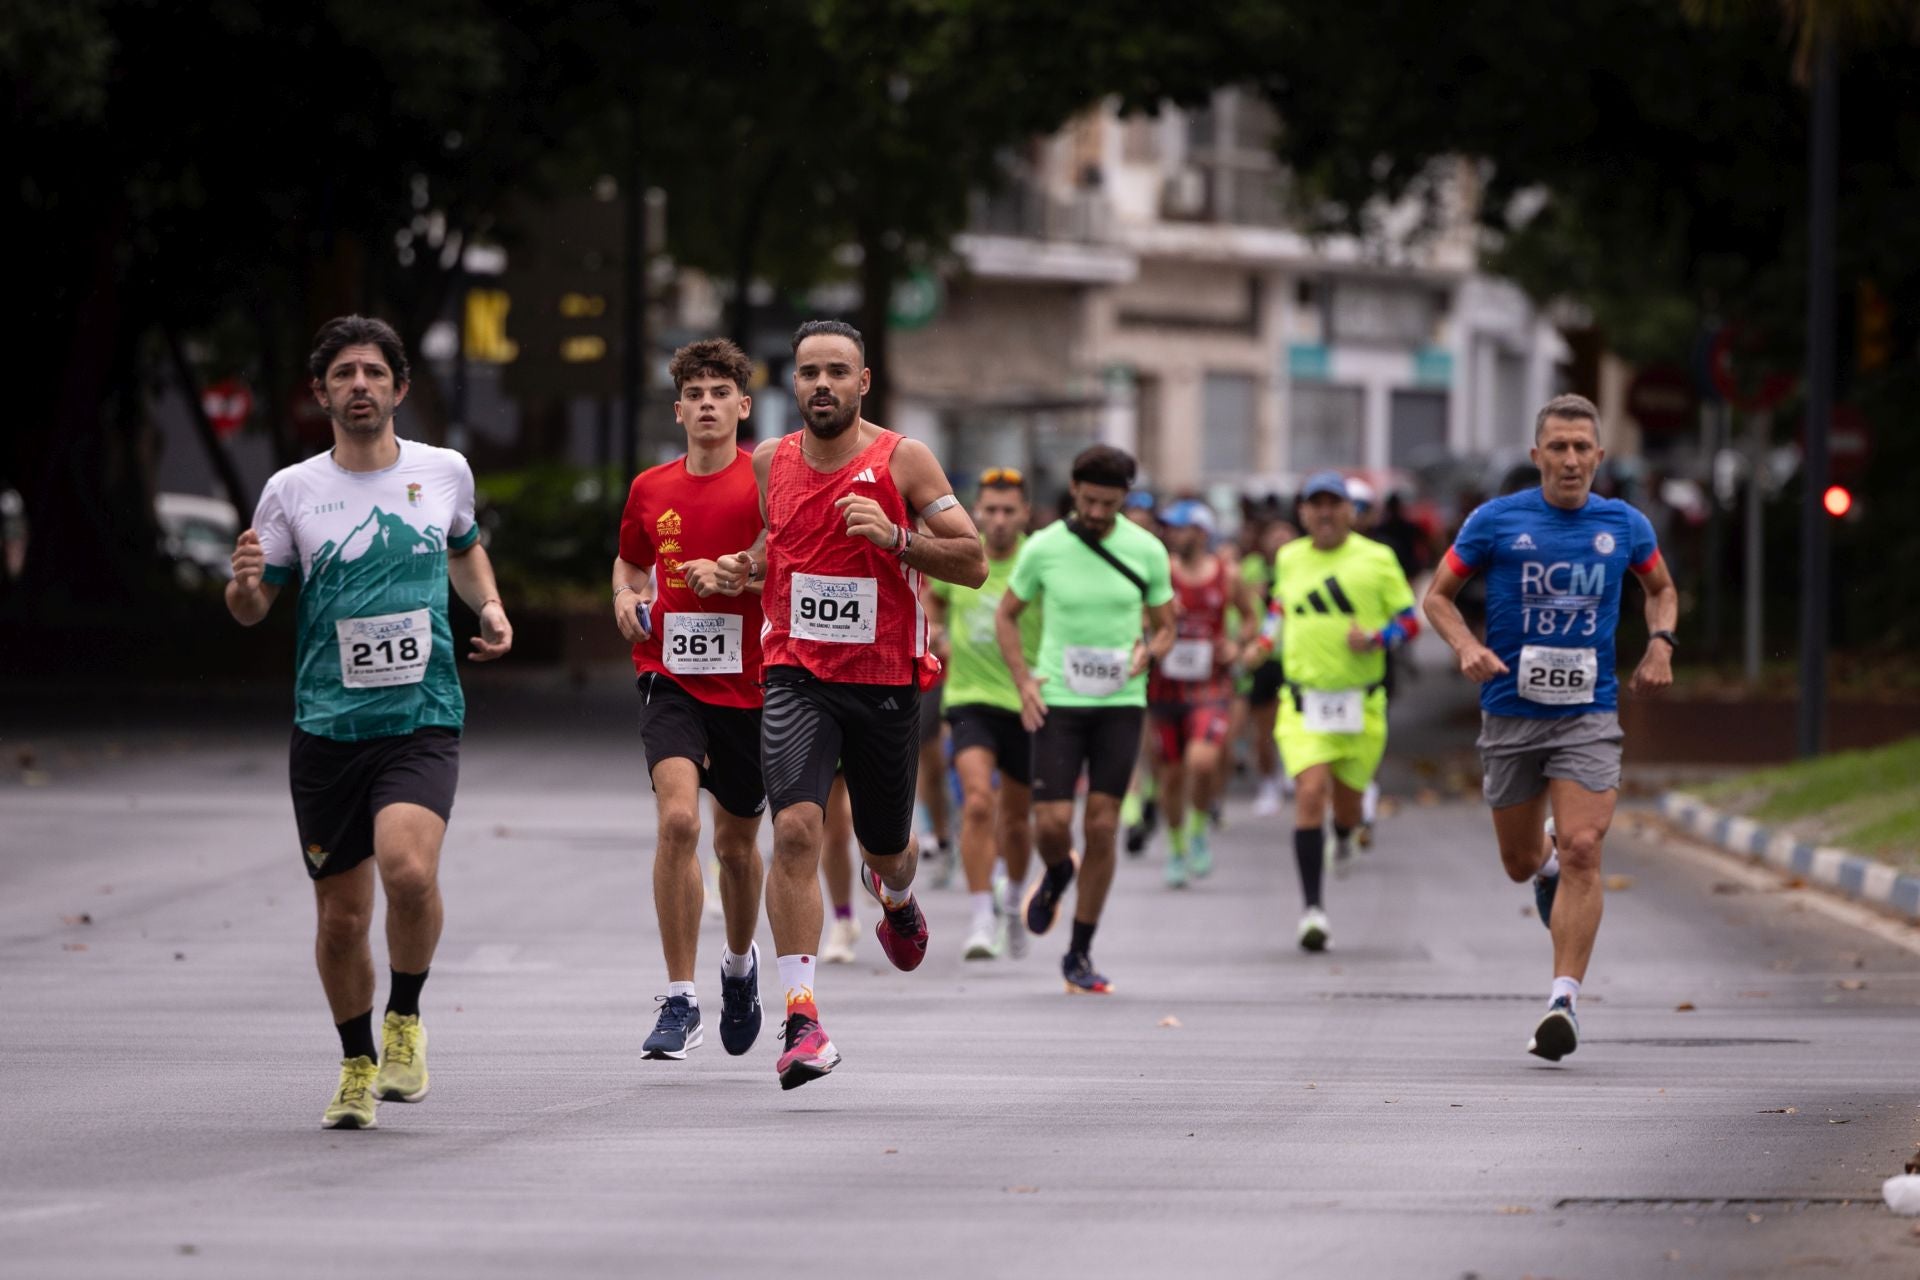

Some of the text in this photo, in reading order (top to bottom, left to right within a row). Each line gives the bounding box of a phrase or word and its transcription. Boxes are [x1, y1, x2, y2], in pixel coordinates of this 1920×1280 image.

[1521, 560, 1606, 596] RCM
[800, 596, 861, 623] 904
[1521, 607, 1597, 636] 1873
[352, 637, 419, 667] 218
[672, 634, 725, 655] 361
[1529, 667, 1585, 688] 266
